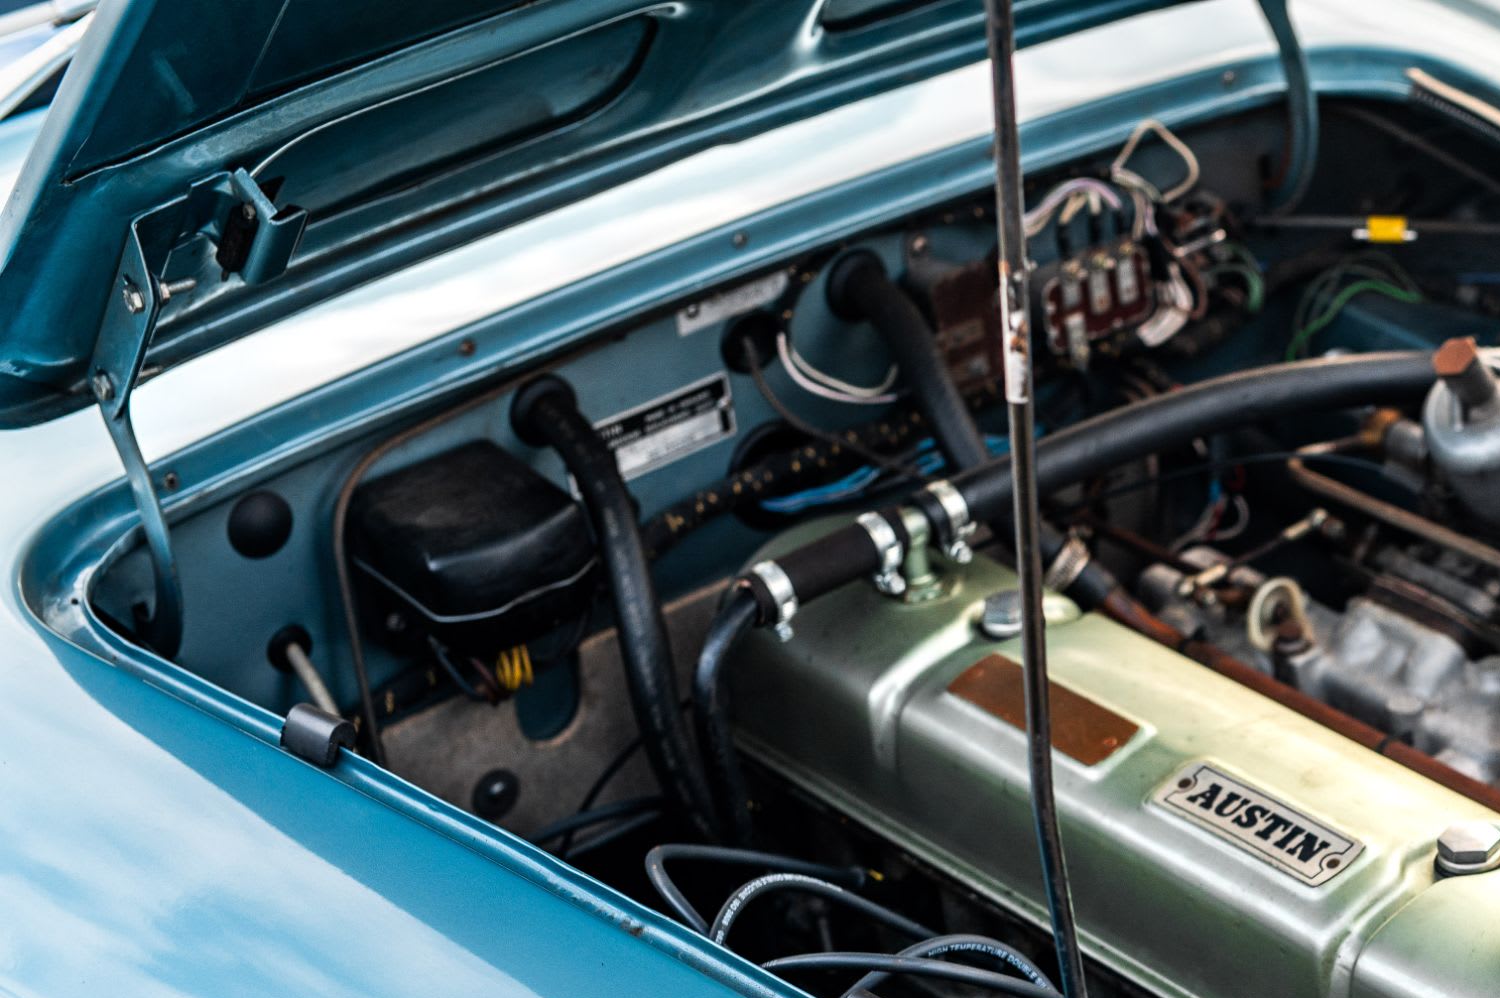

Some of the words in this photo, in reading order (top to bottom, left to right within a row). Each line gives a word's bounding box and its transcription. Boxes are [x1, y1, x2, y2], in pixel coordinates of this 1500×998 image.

[1186, 783, 1330, 863] AUSTIN
[928, 945, 949, 957] HIGH
[950, 943, 1007, 959] TEMPERATURE
[1007, 954, 1038, 980] DOUBLE
